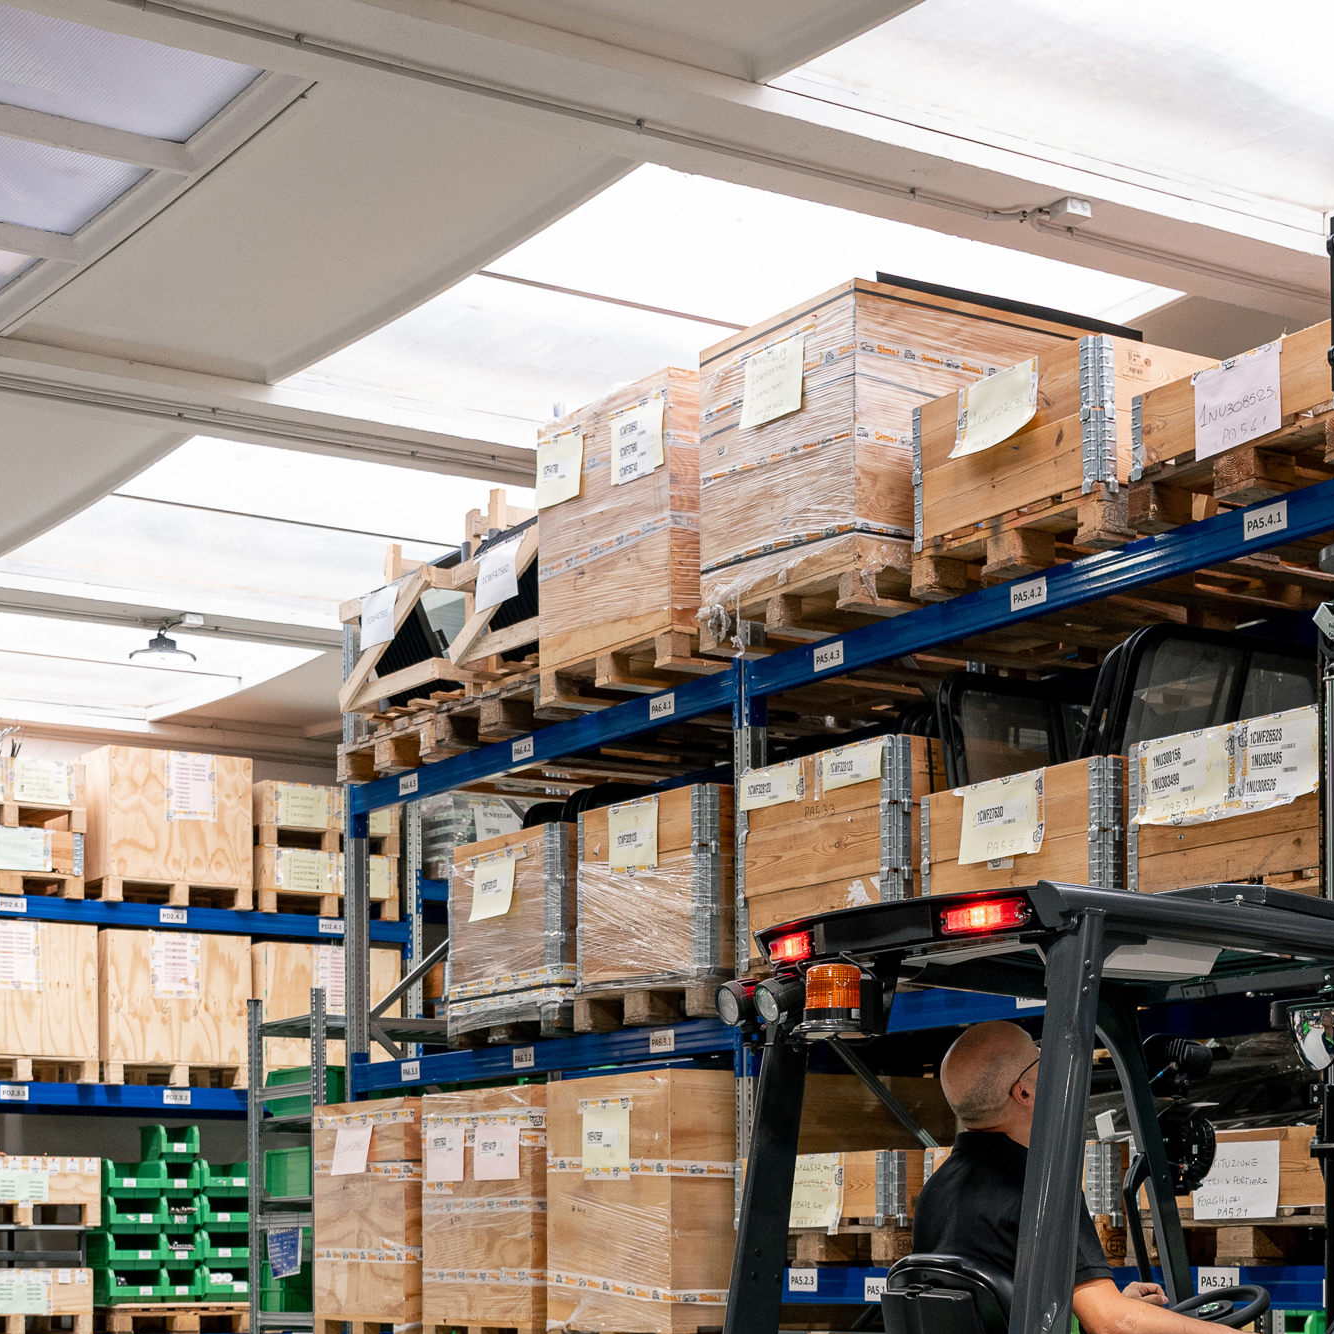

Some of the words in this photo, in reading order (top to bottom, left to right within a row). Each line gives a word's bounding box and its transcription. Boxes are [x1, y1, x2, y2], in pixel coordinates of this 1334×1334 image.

[1247, 511, 1282, 532] PA5.4.1
[1013, 586, 1042, 605] PA5.4.2
[816, 650, 840, 665] PA5.4.3
[651, 701, 672, 714] PA6.4.1
[1249, 727, 1282, 747] 1CWF2652S
[514, 744, 532, 757] PA6.4.2
[1152, 748, 1182, 768] 1NU300156
[1251, 750, 1282, 768] 1NU303485
[1151, 772, 1180, 791] 1NU303499
[0, 901, 24, 909] PD2.4.3
[321, 923, 342, 931] PD2.4.1
[651, 1037, 672, 1048] PA6.3.1
[403, 1067, 418, 1076] PA6.3.3
[791, 1276, 814, 1286] PA5.2.3
[1201, 1277, 1233, 1289] PA5.2.1
